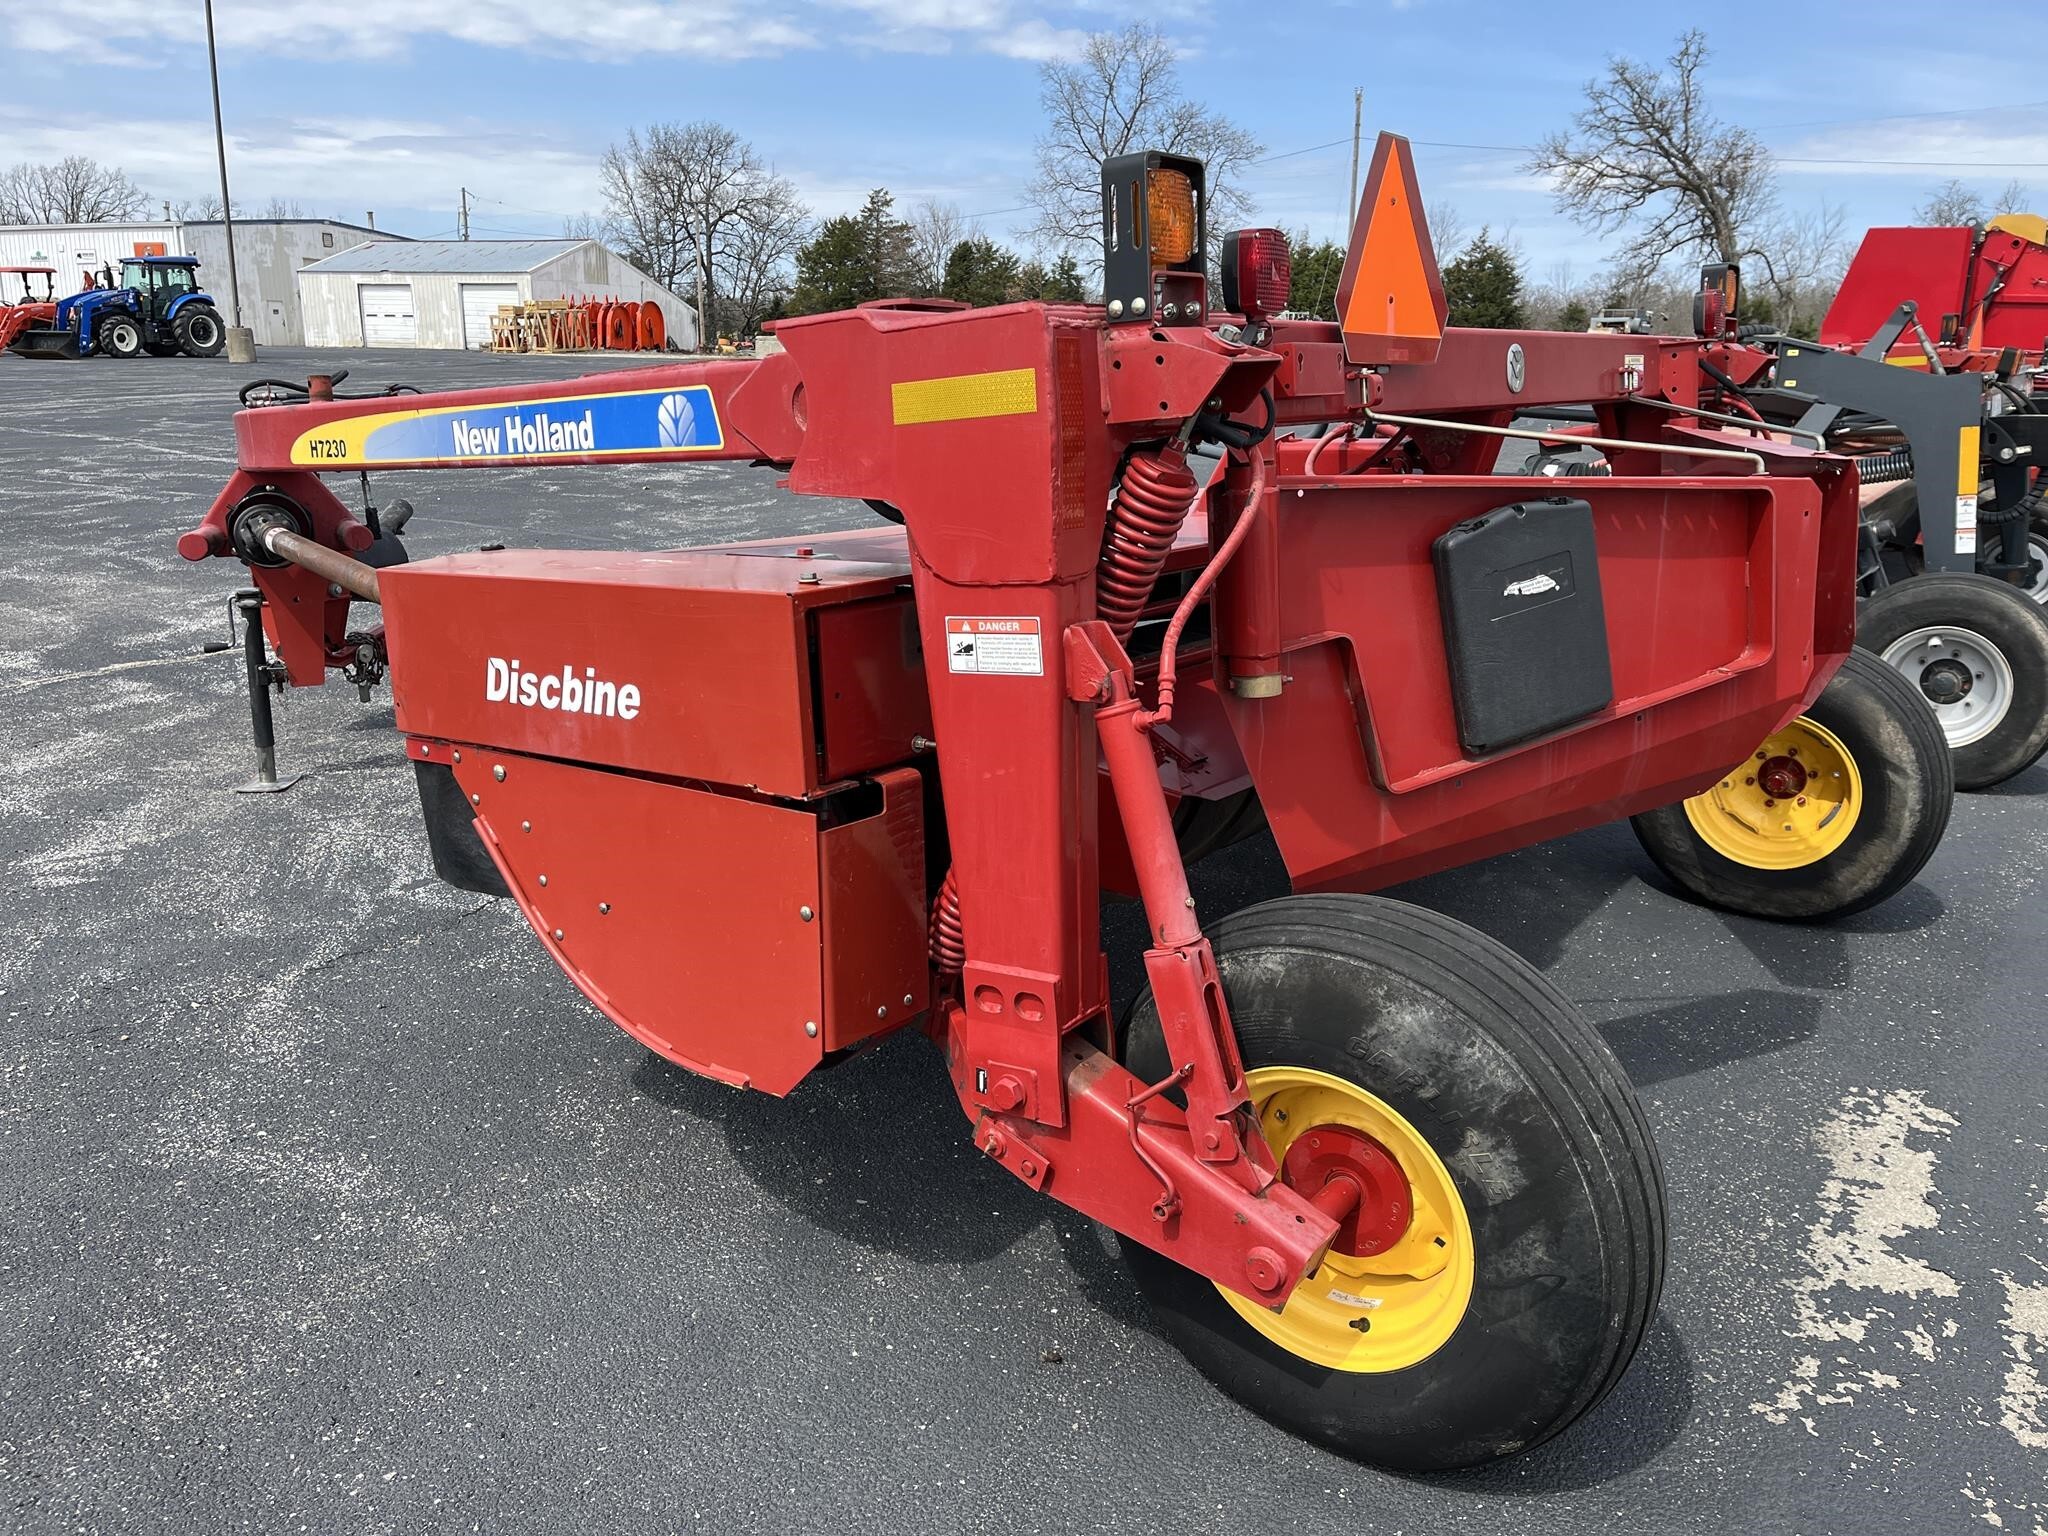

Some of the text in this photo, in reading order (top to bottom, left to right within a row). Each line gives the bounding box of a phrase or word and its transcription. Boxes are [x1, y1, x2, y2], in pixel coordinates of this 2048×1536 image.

[310, 438, 347, 459] H7230
[452, 409, 595, 455] New Holland
[978, 621, 1020, 632] DANGER
[486, 657, 641, 720] Discbine
